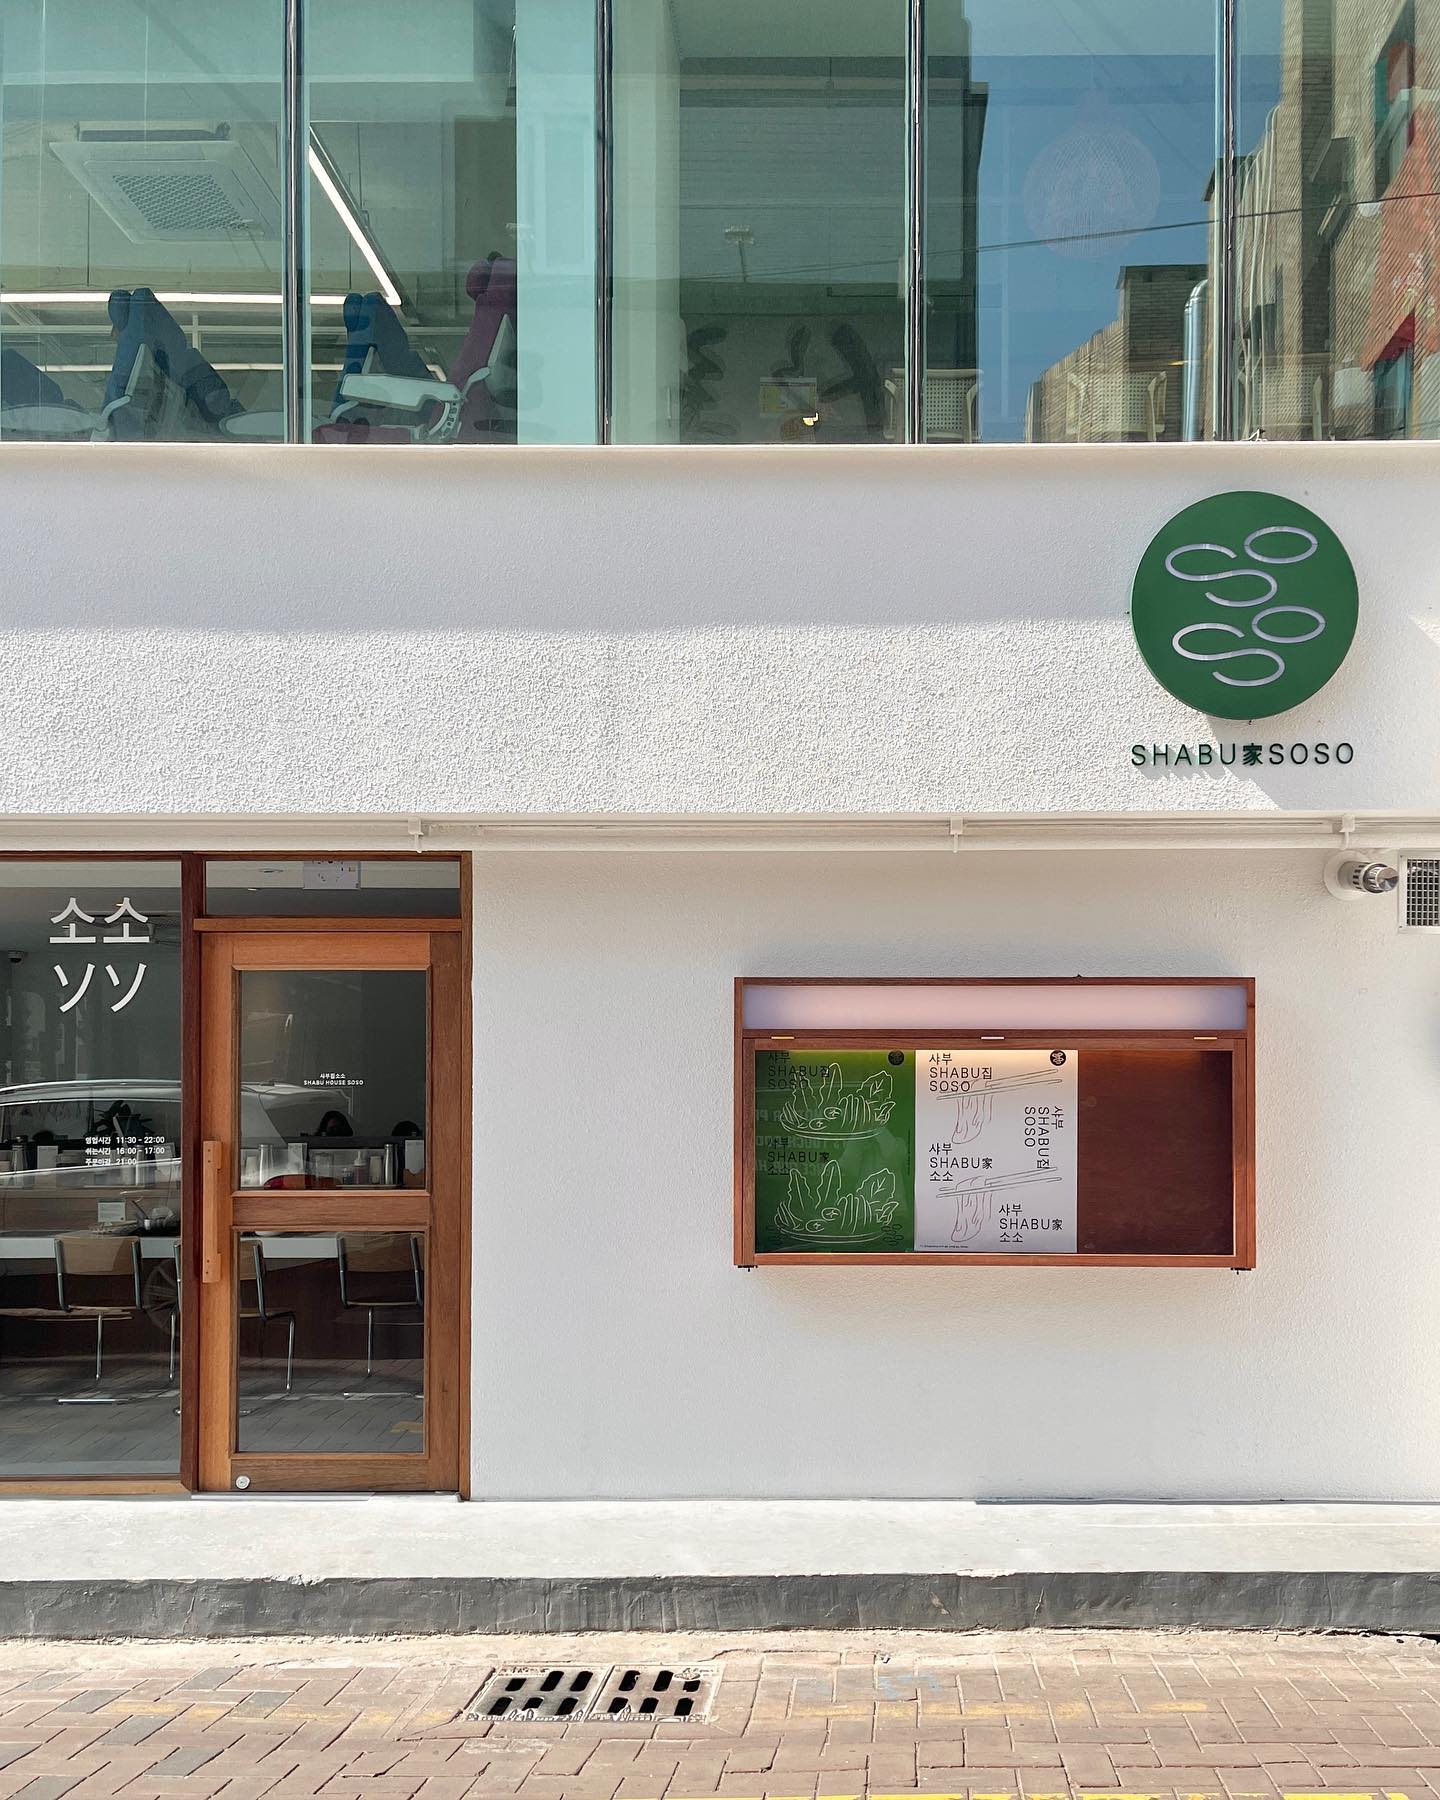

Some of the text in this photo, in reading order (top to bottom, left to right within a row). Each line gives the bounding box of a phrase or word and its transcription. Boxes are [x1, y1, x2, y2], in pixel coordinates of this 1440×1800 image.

[1131, 742, 1354, 766] SHABU家SOSO
[50, 897, 150, 943] 소소
[54, 963, 147, 1012] ソソ
[929, 1052, 952, 1065] 샤부
[929, 1066, 992, 1080] SHABU집
[929, 1080, 970, 1092] SOSO
[1051, 1105, 1064, 1129] 샤부
[1024, 1106, 1036, 1148] SOSO
[85, 1136, 111, 1145] 영업시간
[116, 1136, 137, 1144] 11:30
[143, 1136, 165, 1144] 22:00
[85, 1147, 111, 1156] 쉬는시간
[116, 1147, 137, 1155] 16:00
[144, 1147, 165, 1155] 17:00
[929, 1142, 952, 1155] 샤부
[116, 1158, 137, 1166] 21:00
[929, 1157, 993, 1169] SHABU家
[929, 1170, 954, 1182] 소소
[998, 1203, 1023, 1216] 샤부
[999, 1218, 1063, 1231] SHABU家
[999, 1231, 1024, 1243] 소소
